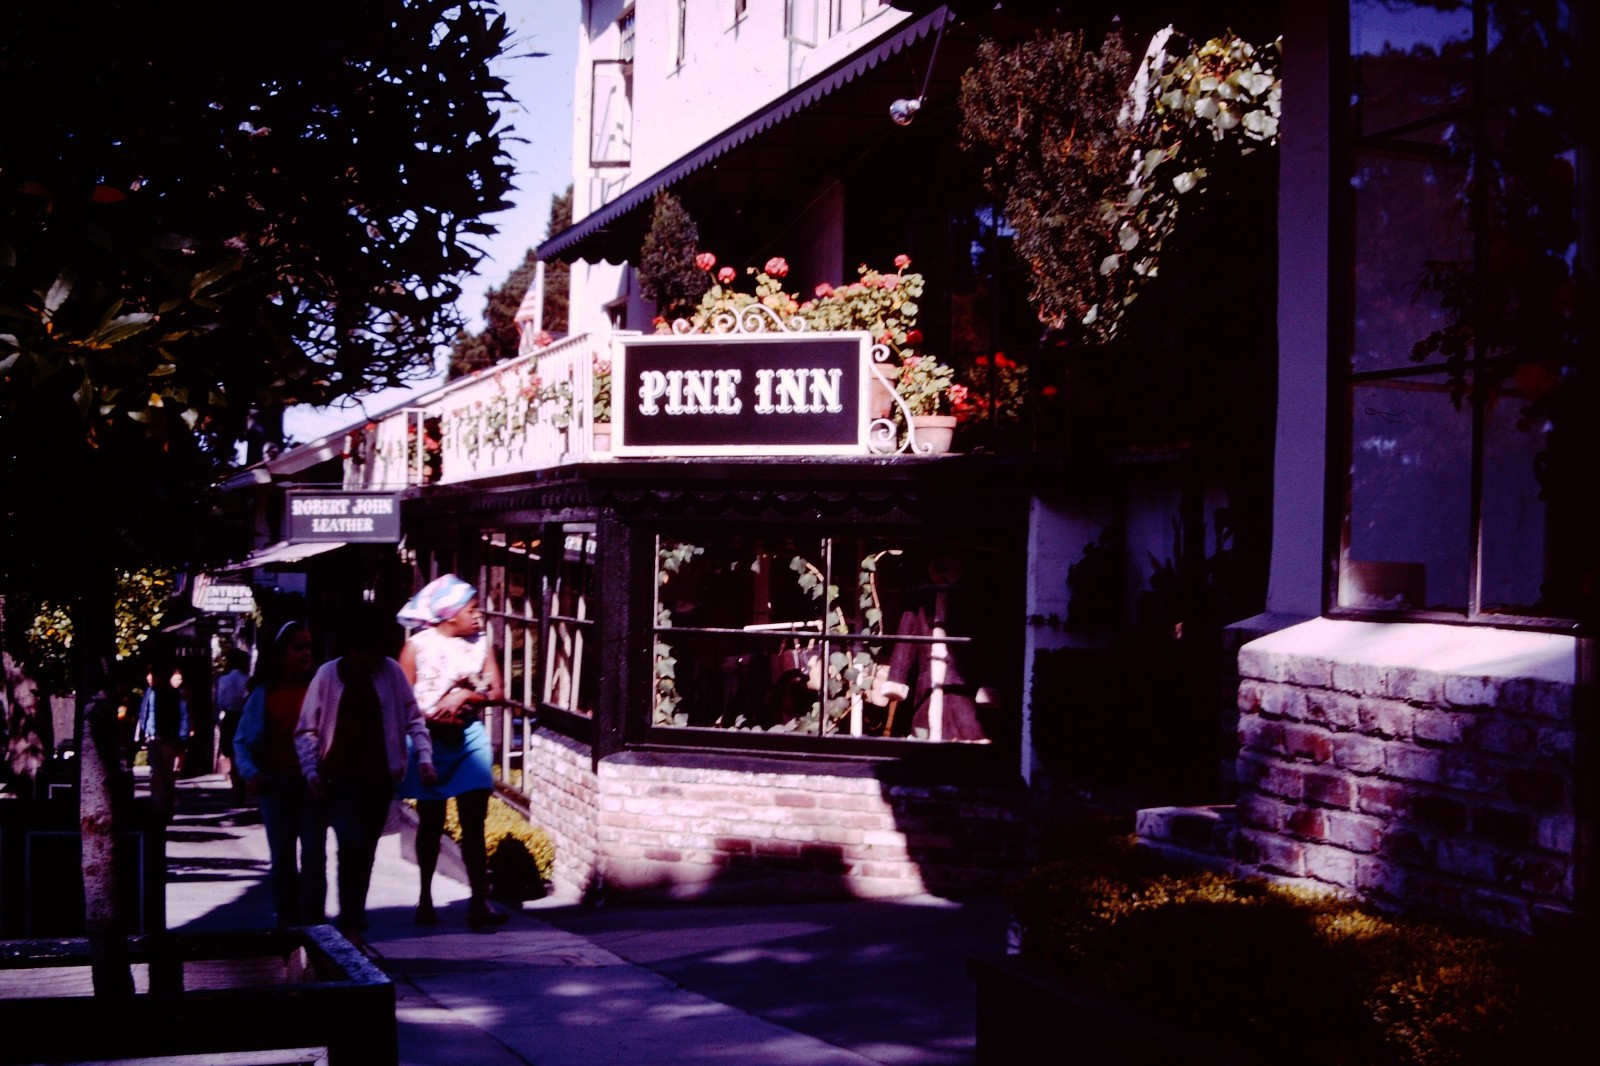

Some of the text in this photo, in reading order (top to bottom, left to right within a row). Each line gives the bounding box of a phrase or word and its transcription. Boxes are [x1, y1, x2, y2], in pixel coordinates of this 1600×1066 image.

[639, 368, 843, 416] PINE INN
[291, 498, 393, 516] ROBERT JOHN
[312, 517, 374, 532] LEATHER
